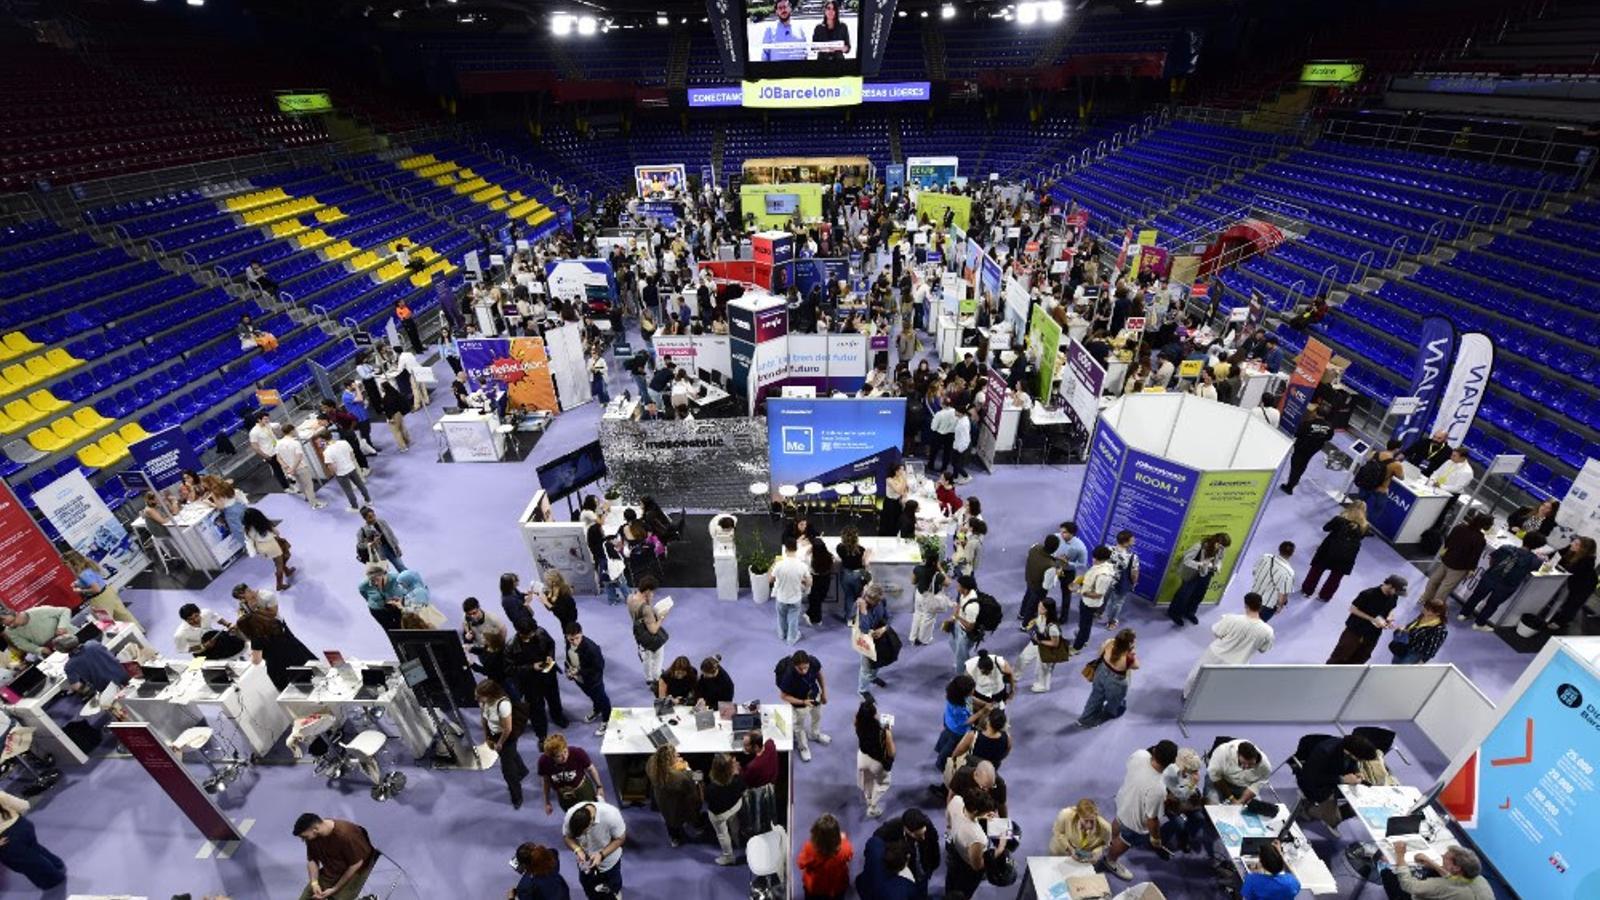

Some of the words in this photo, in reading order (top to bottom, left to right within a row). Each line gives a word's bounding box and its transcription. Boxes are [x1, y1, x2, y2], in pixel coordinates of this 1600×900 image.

[1135, 472, 1172, 492] ROOM
[1173, 486, 1179, 494] 1
[1566, 748, 1595, 775] 25.000
